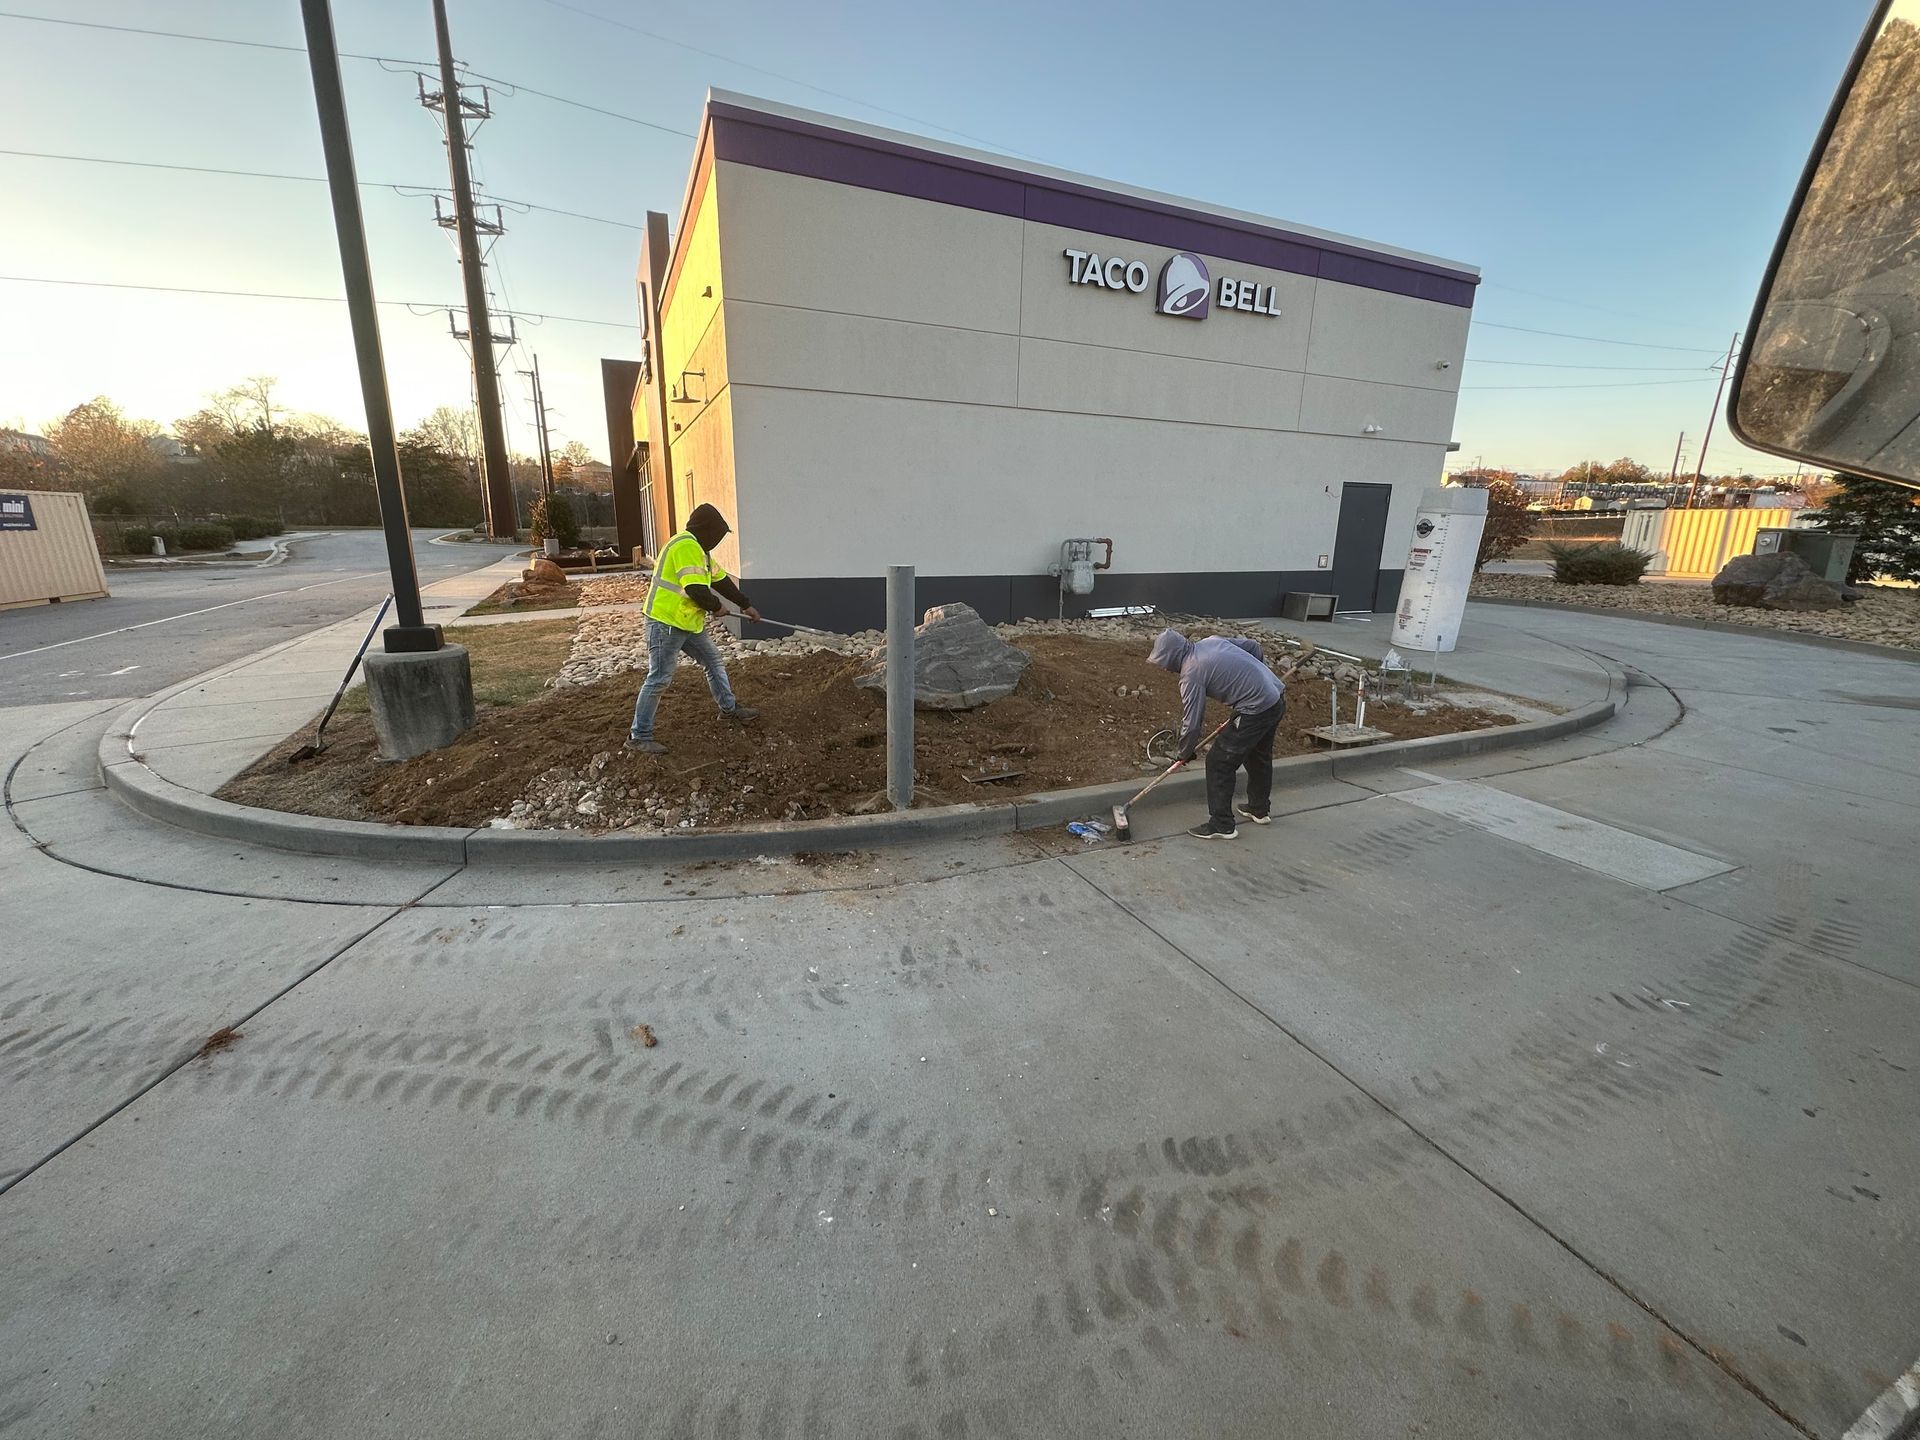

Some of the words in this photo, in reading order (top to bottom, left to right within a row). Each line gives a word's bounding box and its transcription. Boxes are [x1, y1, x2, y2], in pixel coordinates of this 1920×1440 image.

[1064, 248, 1149, 294] TACO
[1216, 276, 1282, 317] BELL
[2, 500, 25, 513] mini
